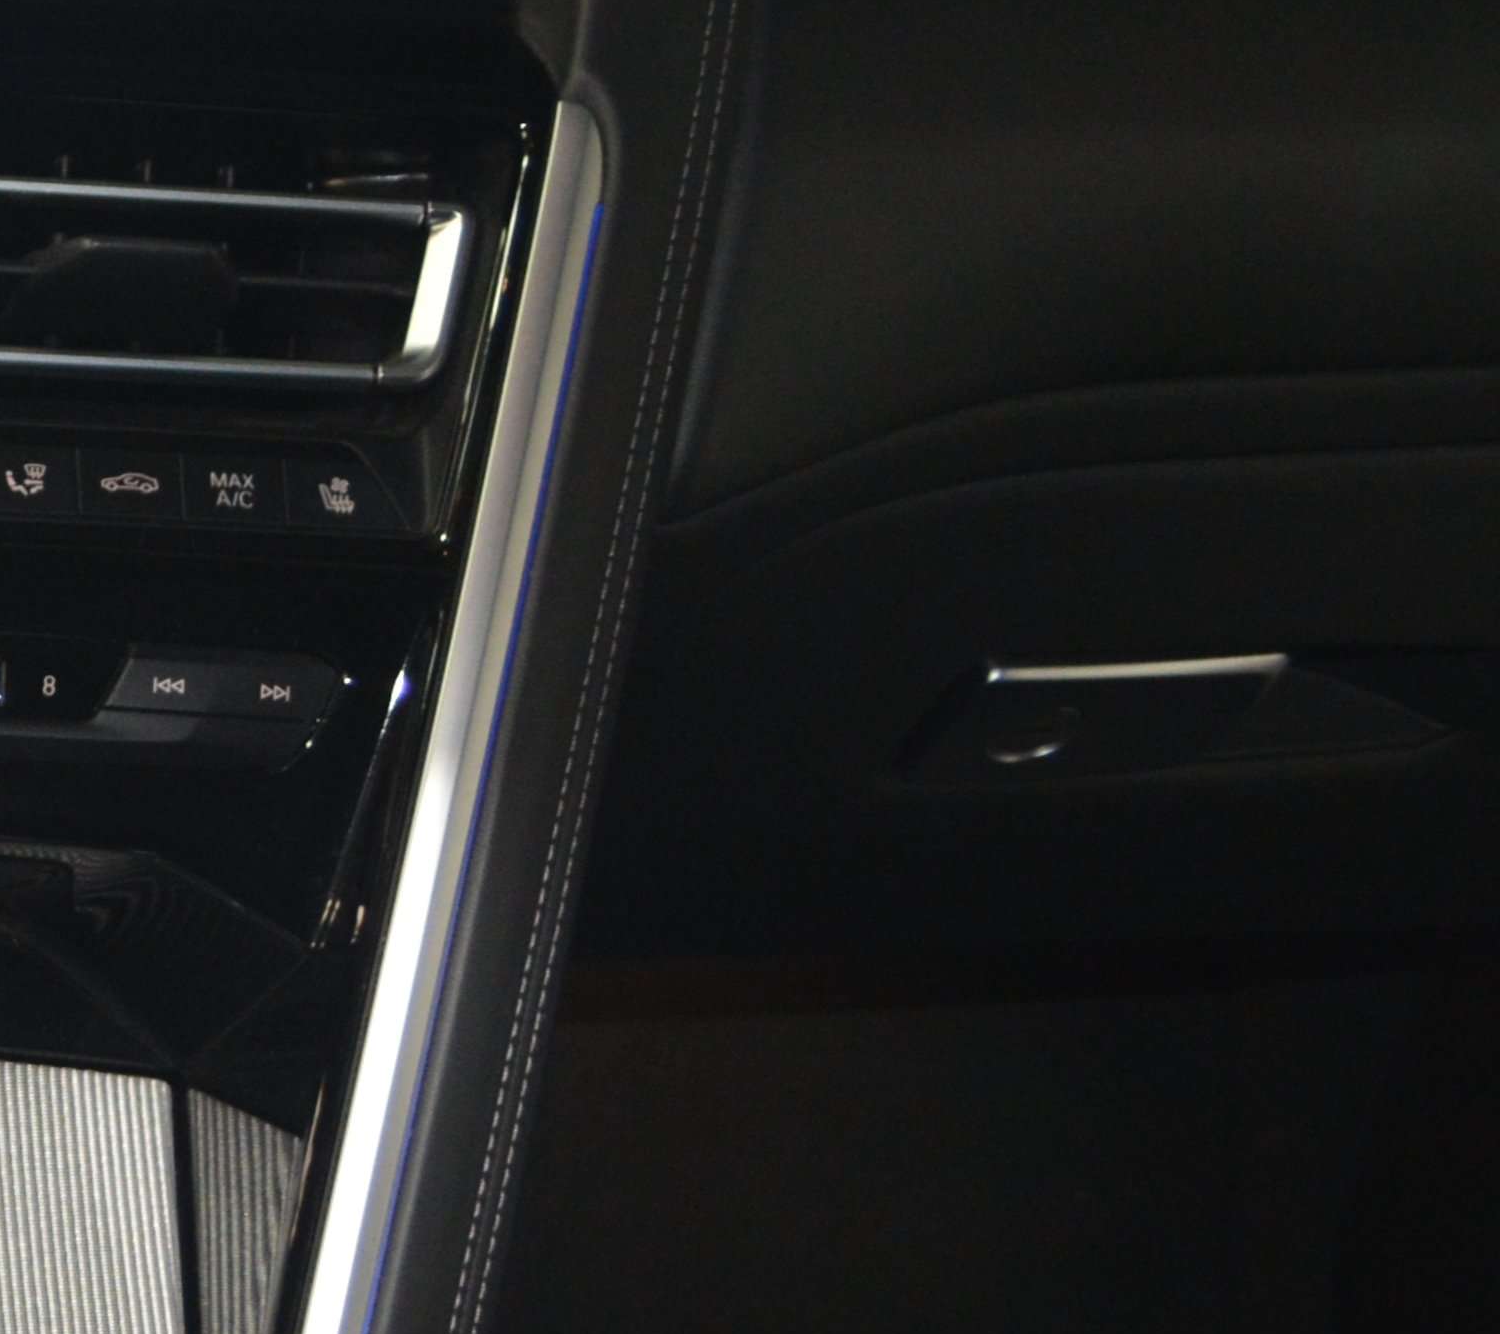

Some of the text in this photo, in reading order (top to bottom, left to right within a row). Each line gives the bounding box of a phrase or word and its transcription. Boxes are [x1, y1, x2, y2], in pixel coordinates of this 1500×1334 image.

[210, 472, 254, 491] MAX
[216, 490, 253, 509] A/C
[42, 675, 56, 696] 8
